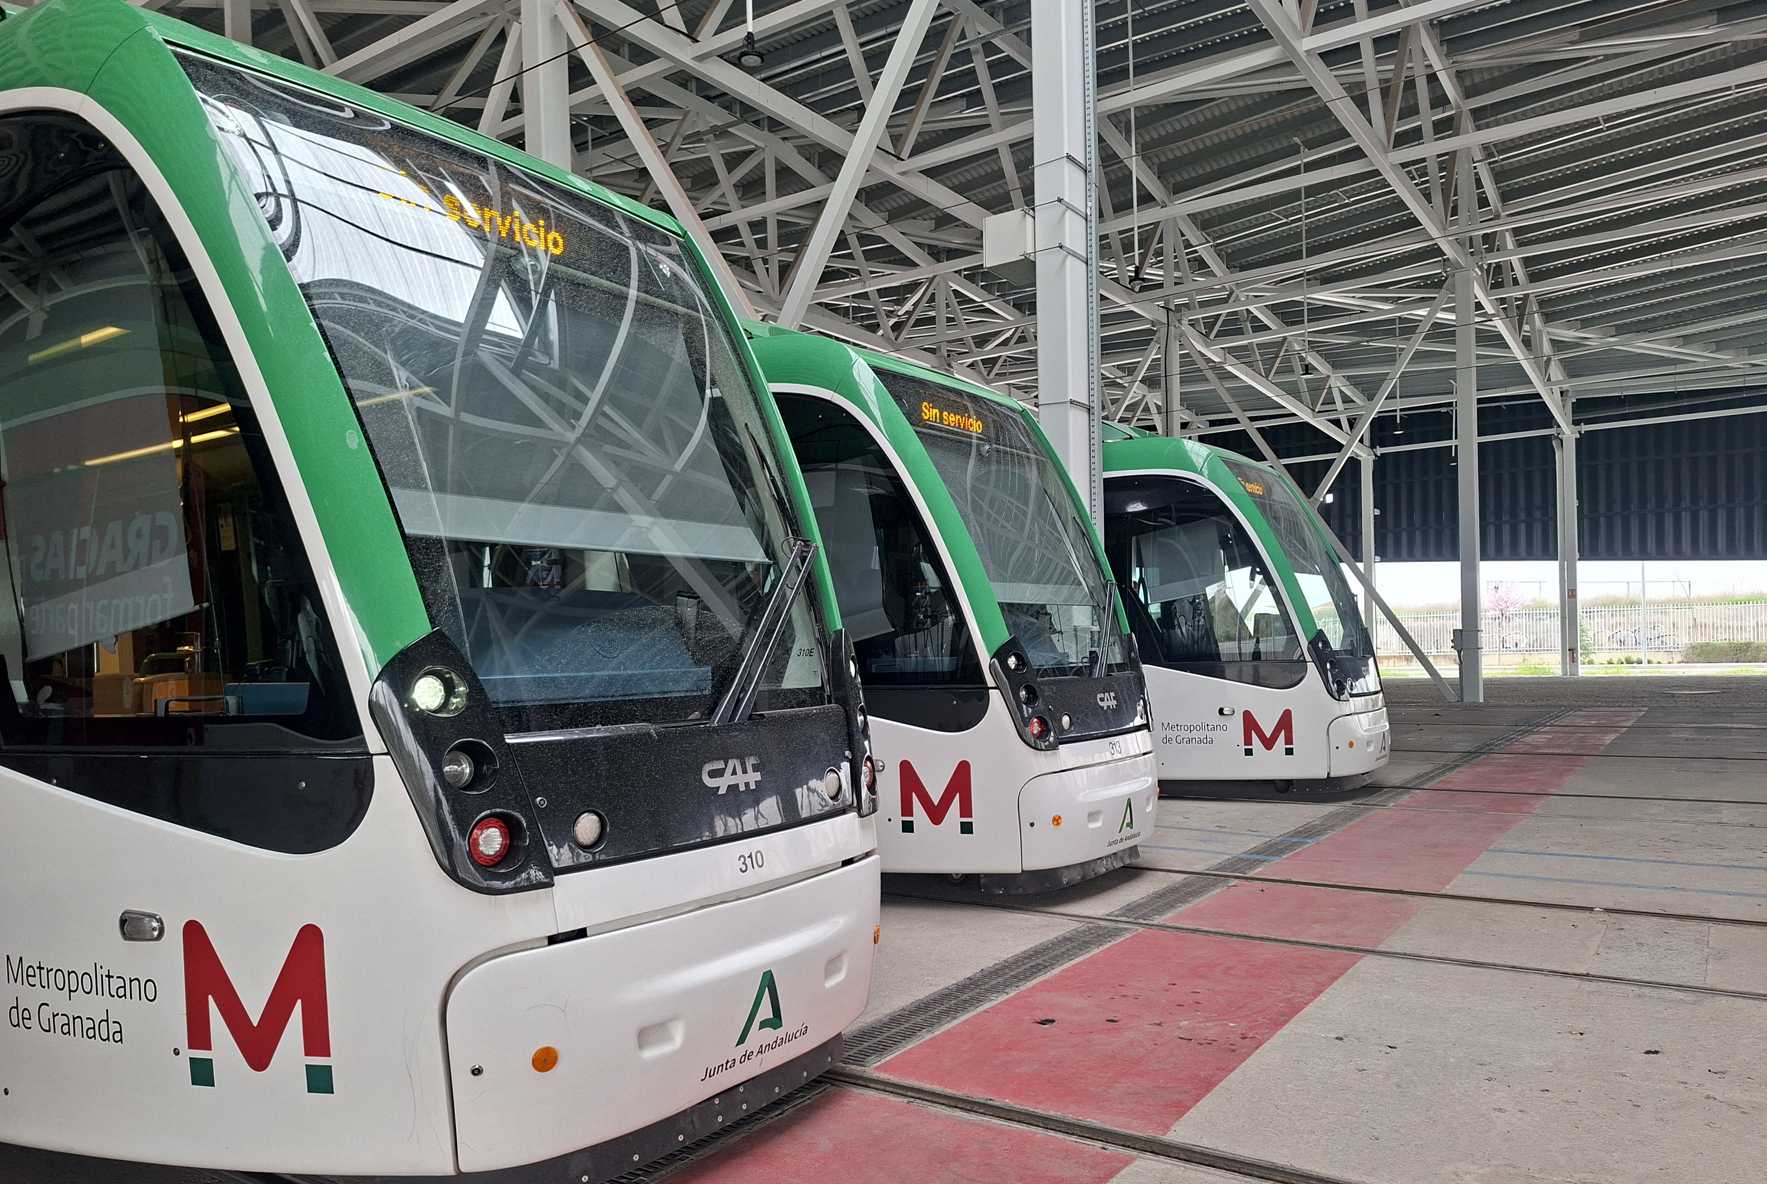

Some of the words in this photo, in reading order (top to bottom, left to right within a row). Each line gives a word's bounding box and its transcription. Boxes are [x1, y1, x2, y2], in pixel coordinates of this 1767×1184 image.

[921, 401, 940, 422] Sin
[942, 410, 983, 433] servicio
[1161, 722, 1228, 733] Metropolitano
[1161, 734, 1173, 745] de
[1175, 734, 1214, 745] Granada
[702, 757, 762, 795] CAF
[737, 850, 765, 873] 310
[6, 954, 157, 1002] Metropolitano
[8, 997, 32, 1031] de
[37, 1002, 124, 1044] Granada
[700, 1058, 736, 1082] Junta
[739, 1048, 754, 1065] de
[755, 1022, 808, 1057] Andalucía
